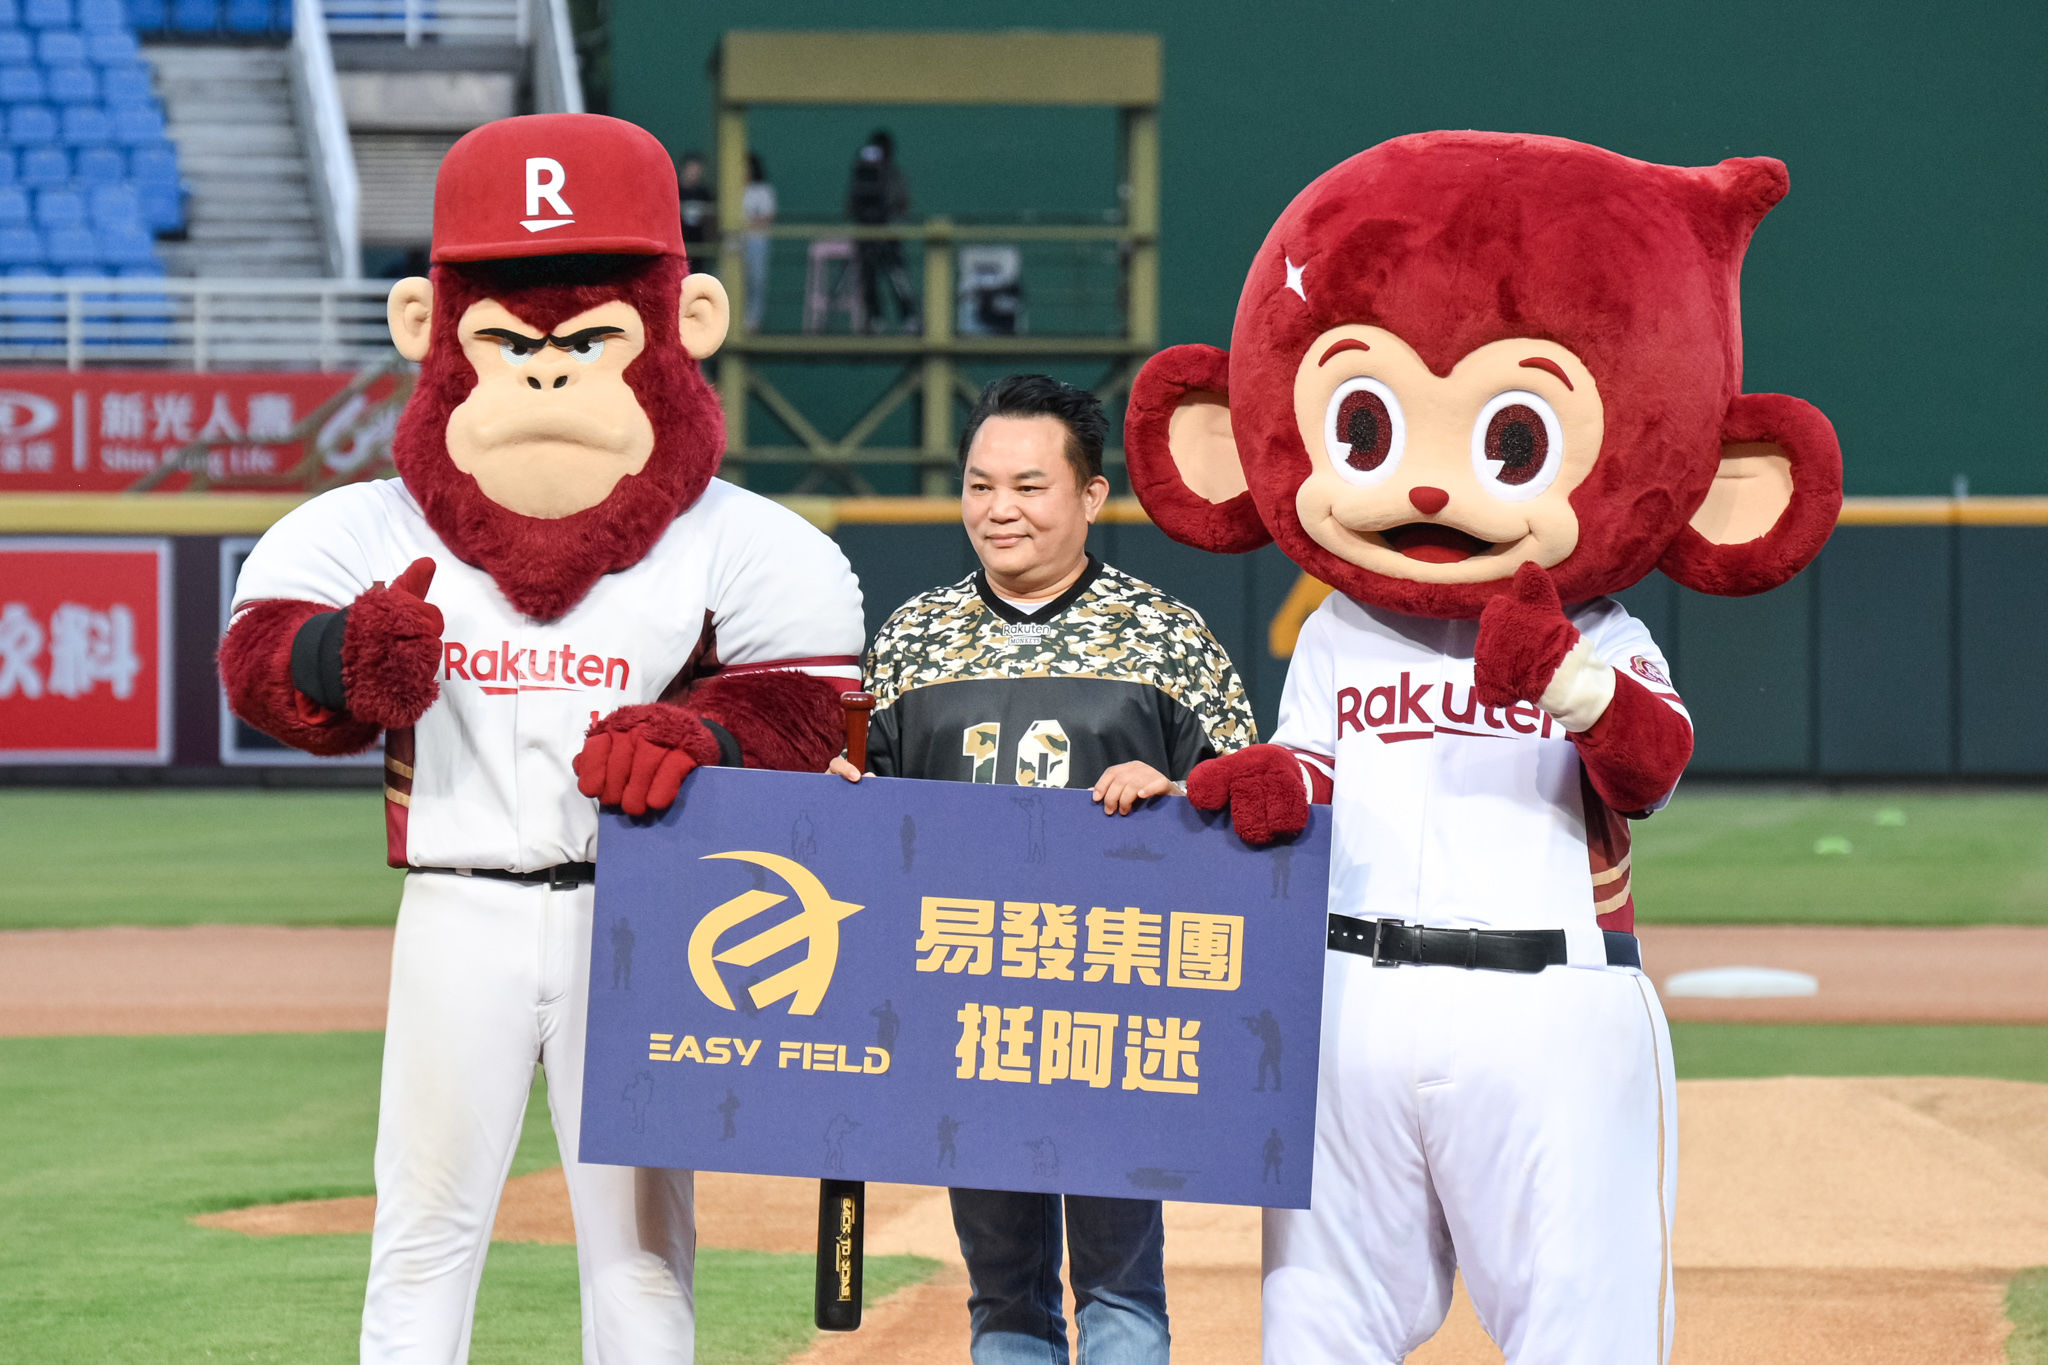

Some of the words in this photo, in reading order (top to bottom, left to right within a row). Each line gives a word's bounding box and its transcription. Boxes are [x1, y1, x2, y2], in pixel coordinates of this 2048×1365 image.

[526, 157, 574, 216] R
[1003, 622, 1050, 635] Rakuten
[444, 640, 630, 691] Rakuten
[963, 719, 1070, 788] 10
[915, 896, 1244, 991] 易發集團
[649, 1033, 762, 1066] EASY
[779, 1041, 891, 1075] FIELD
[955, 1002, 1201, 1095] 挺阿迷
